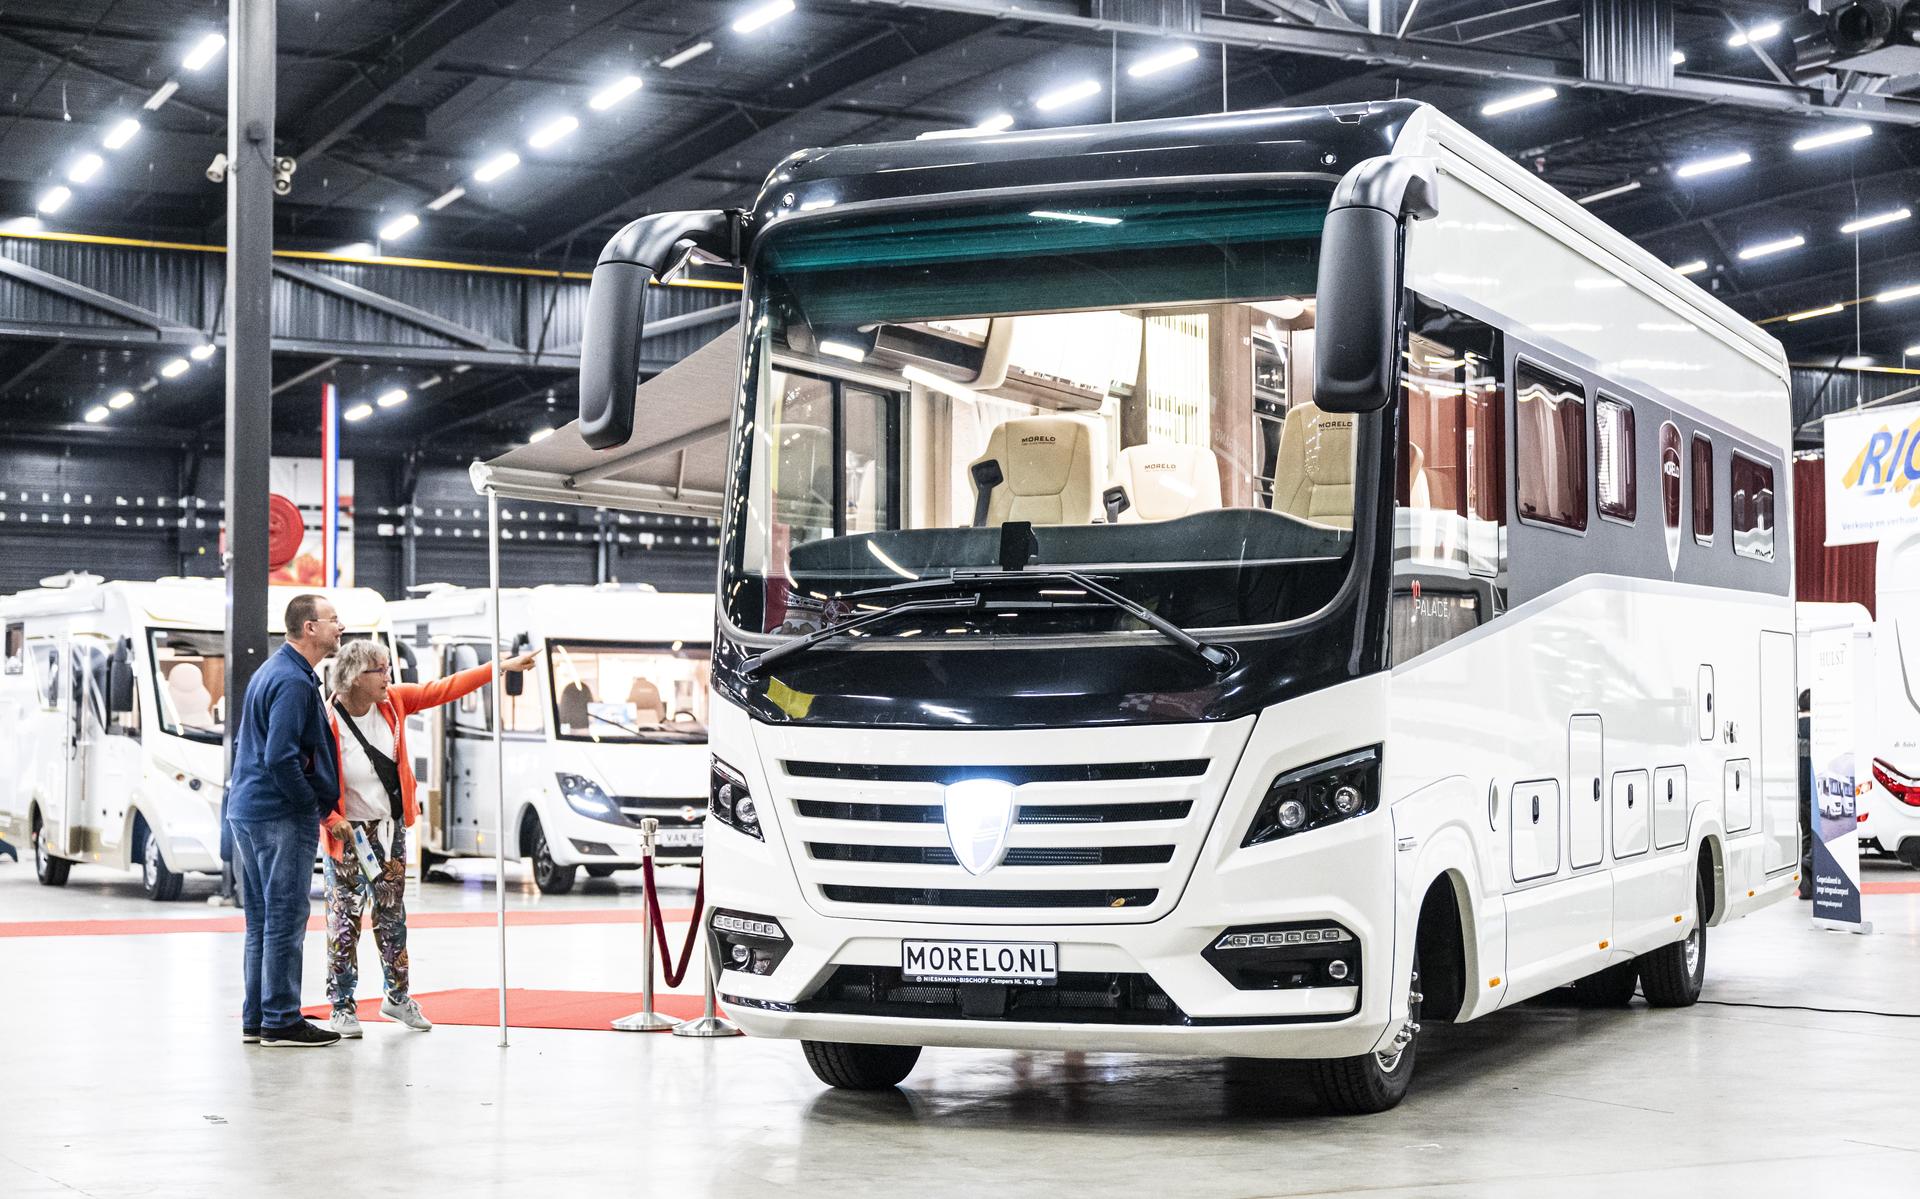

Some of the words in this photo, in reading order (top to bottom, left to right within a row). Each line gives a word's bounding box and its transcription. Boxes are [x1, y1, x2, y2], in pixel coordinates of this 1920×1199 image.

[1416, 599, 1449, 617] PALACE
[666, 833, 687, 842] VAN
[907, 946, 1055, 973] MORELO.NL
